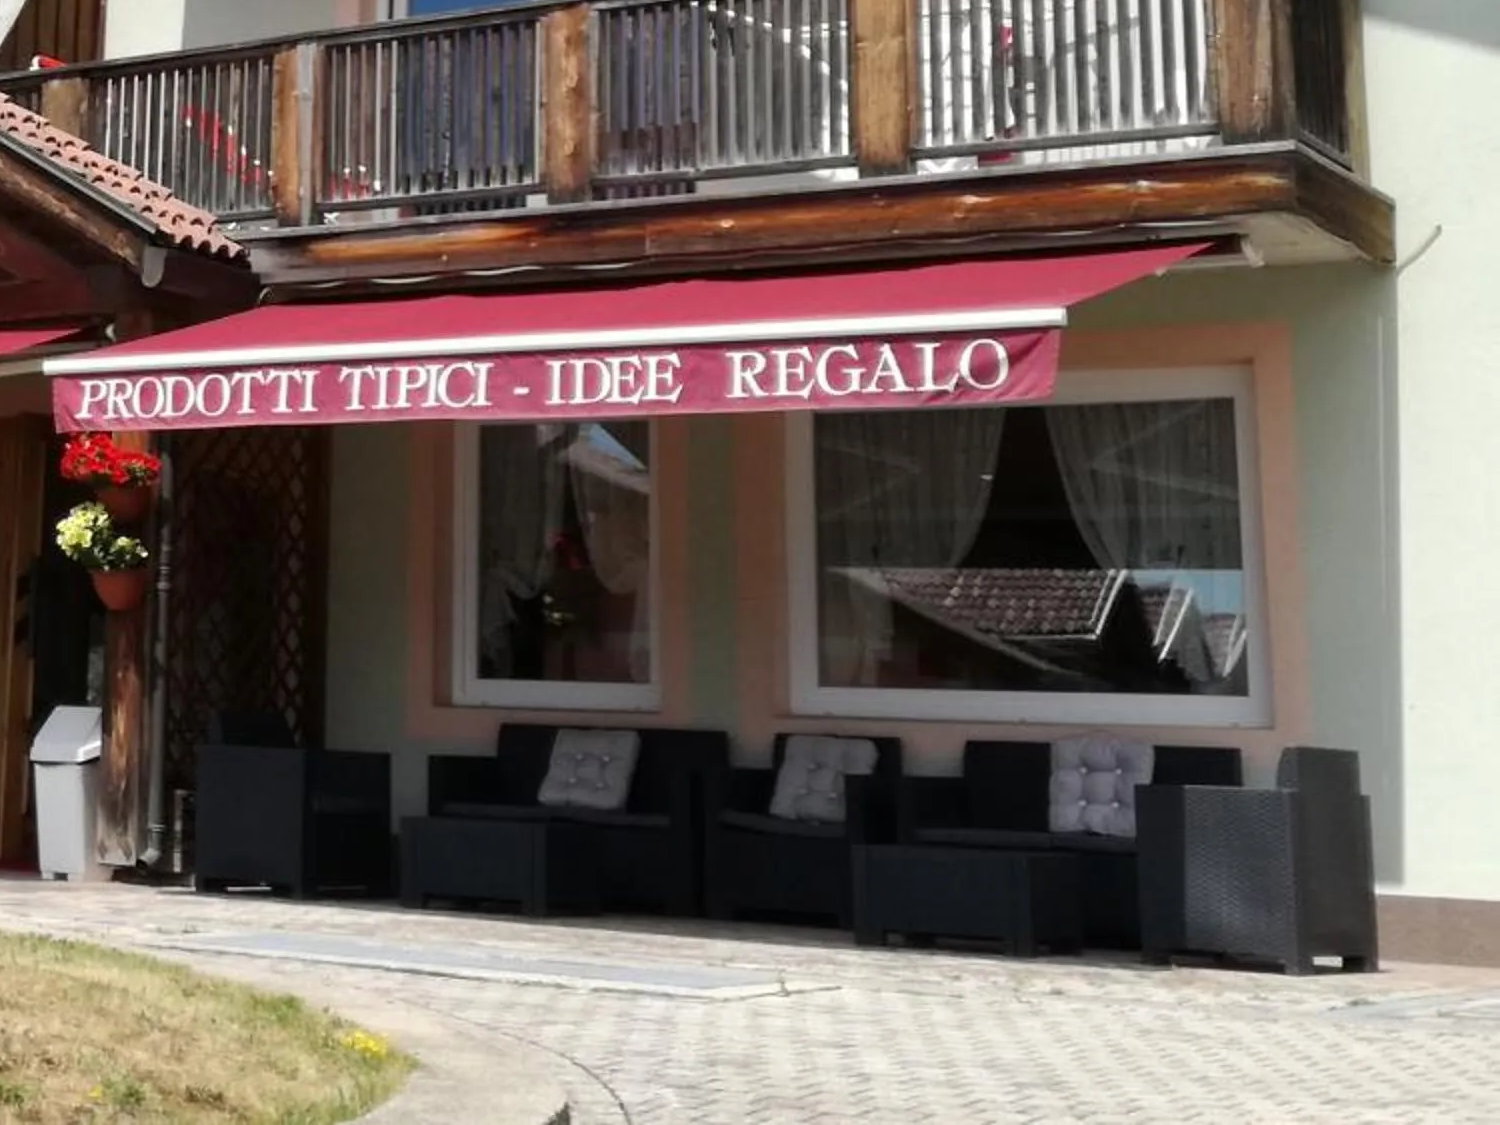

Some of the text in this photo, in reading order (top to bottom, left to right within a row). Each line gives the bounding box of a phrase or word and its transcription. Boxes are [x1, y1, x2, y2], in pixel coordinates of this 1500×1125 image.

[77, 368, 320, 420] PRODOTTI
[340, 361, 495, 410] TIPICI
[545, 352, 683, 405] IDEE
[725, 338, 1009, 400] REGALO
